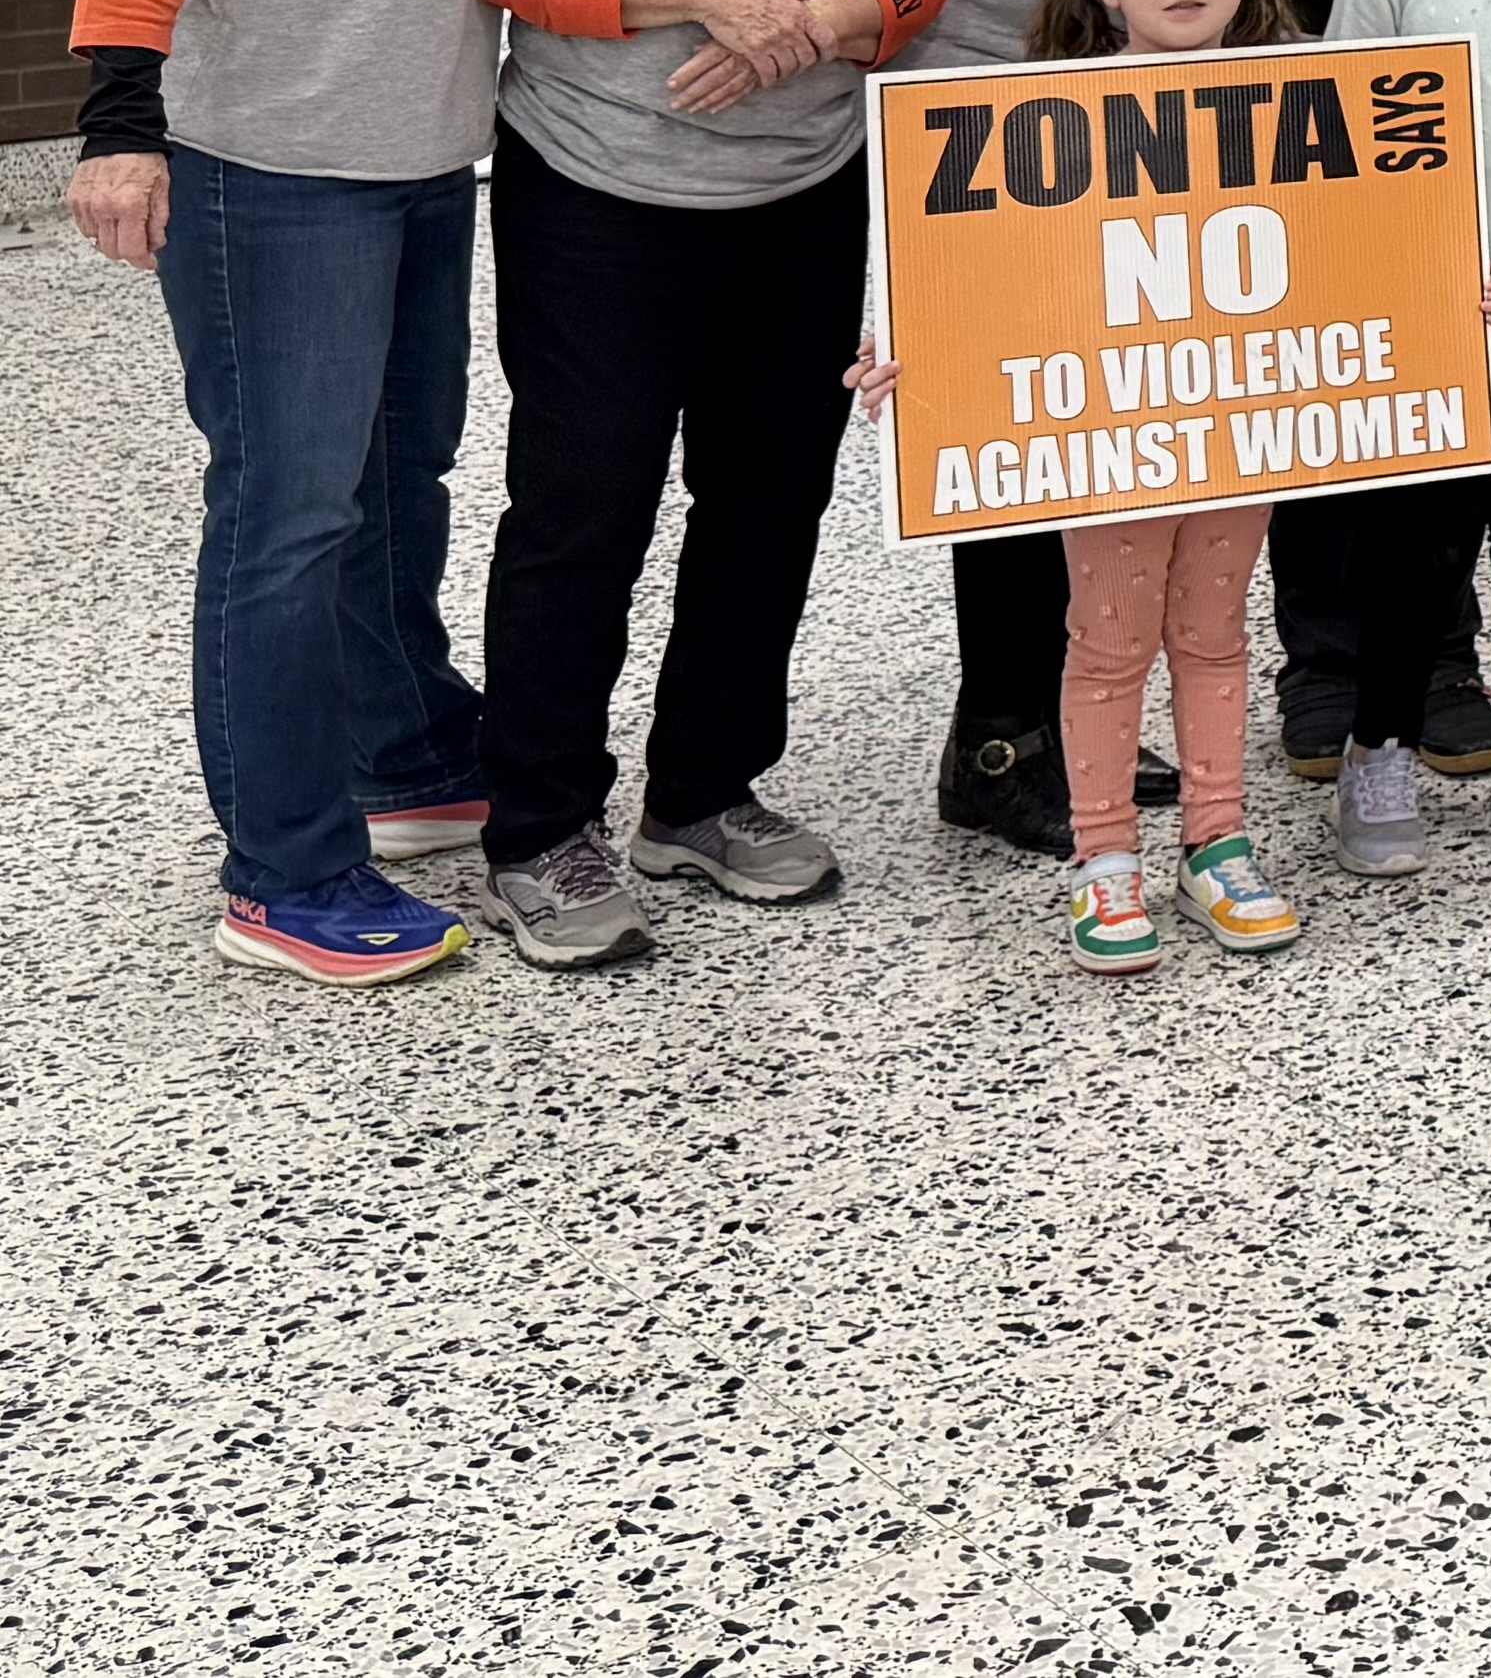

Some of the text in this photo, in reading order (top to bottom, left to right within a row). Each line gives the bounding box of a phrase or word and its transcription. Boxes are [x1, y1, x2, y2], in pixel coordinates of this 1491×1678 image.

[924, 70, 1449, 216] ZONTA SAYS
[1100, 203, 1290, 328] NO
[1000, 317, 1396, 424] TO VIOLENCE
[931, 385, 1466, 517] AGAINST WOMEN
